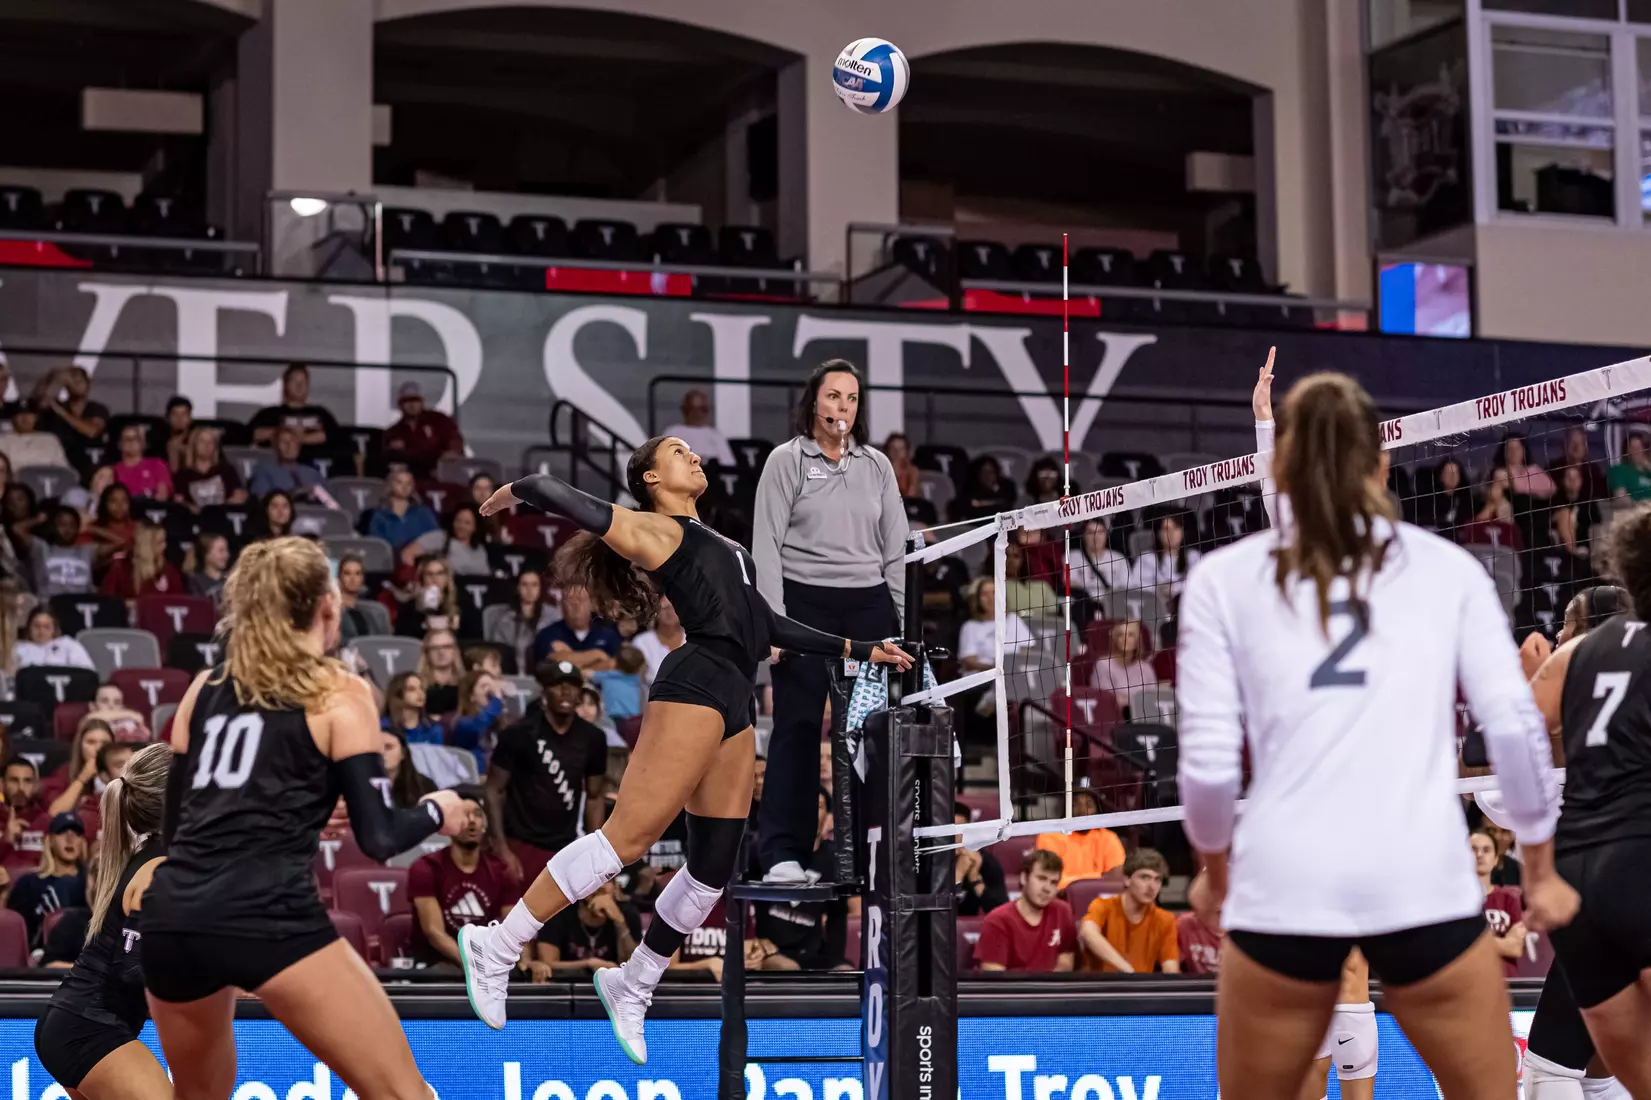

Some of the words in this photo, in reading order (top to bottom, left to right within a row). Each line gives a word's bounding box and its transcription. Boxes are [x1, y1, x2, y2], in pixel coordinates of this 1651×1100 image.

[837, 57, 872, 77] molten
[1475, 393, 1507, 420] TROY
[1510, 379, 1567, 412] TROJANS
[1183, 464, 1209, 490] TROY
[1210, 455, 1255, 484] TROJANS
[1058, 496, 1082, 518] TROY
[1083, 486, 1124, 514] TROJANS
[736, 550, 751, 585] 1
[1309, 601, 1368, 688] 2
[1621, 621, 1648, 648] T
[1584, 671, 1632, 747] 7
[192, 712, 263, 788] 10
[122, 928, 141, 953] T
[867, 826, 884, 1100] TROY
[916, 1026, 934, 1082] sports
